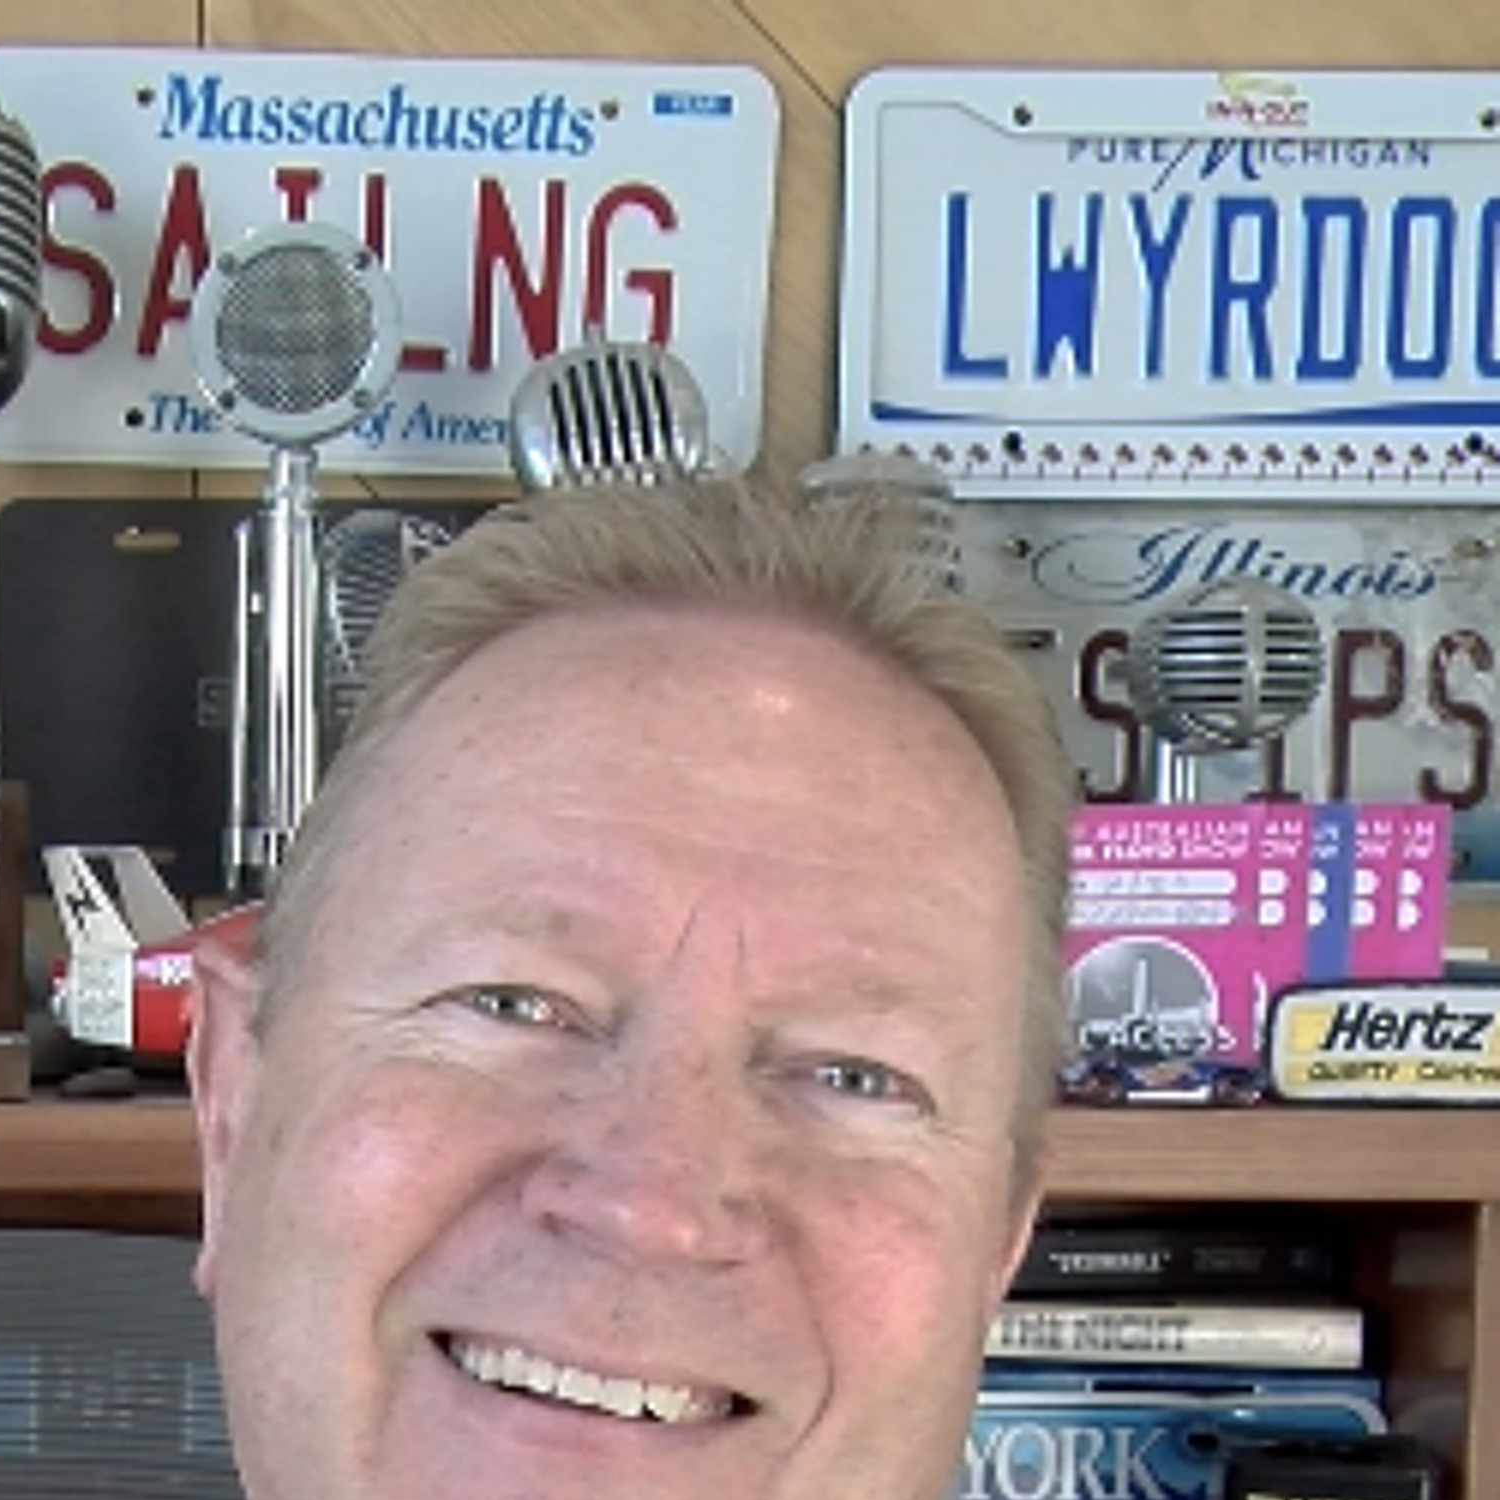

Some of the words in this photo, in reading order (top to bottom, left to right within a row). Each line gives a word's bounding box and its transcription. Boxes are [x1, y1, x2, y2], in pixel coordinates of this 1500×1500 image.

[157, 73, 598, 157] Massachusetts
[1068, 138, 1172, 164] PURE
[37, 162, 678, 374] SALNG
[149, 395, 214, 433] The
[354, 400, 397, 449] of
[401, 400, 511, 444] Amer
[1032, 522, 1446, 604] Illinois
[1320, 1001, 1494, 1051] Hertz
